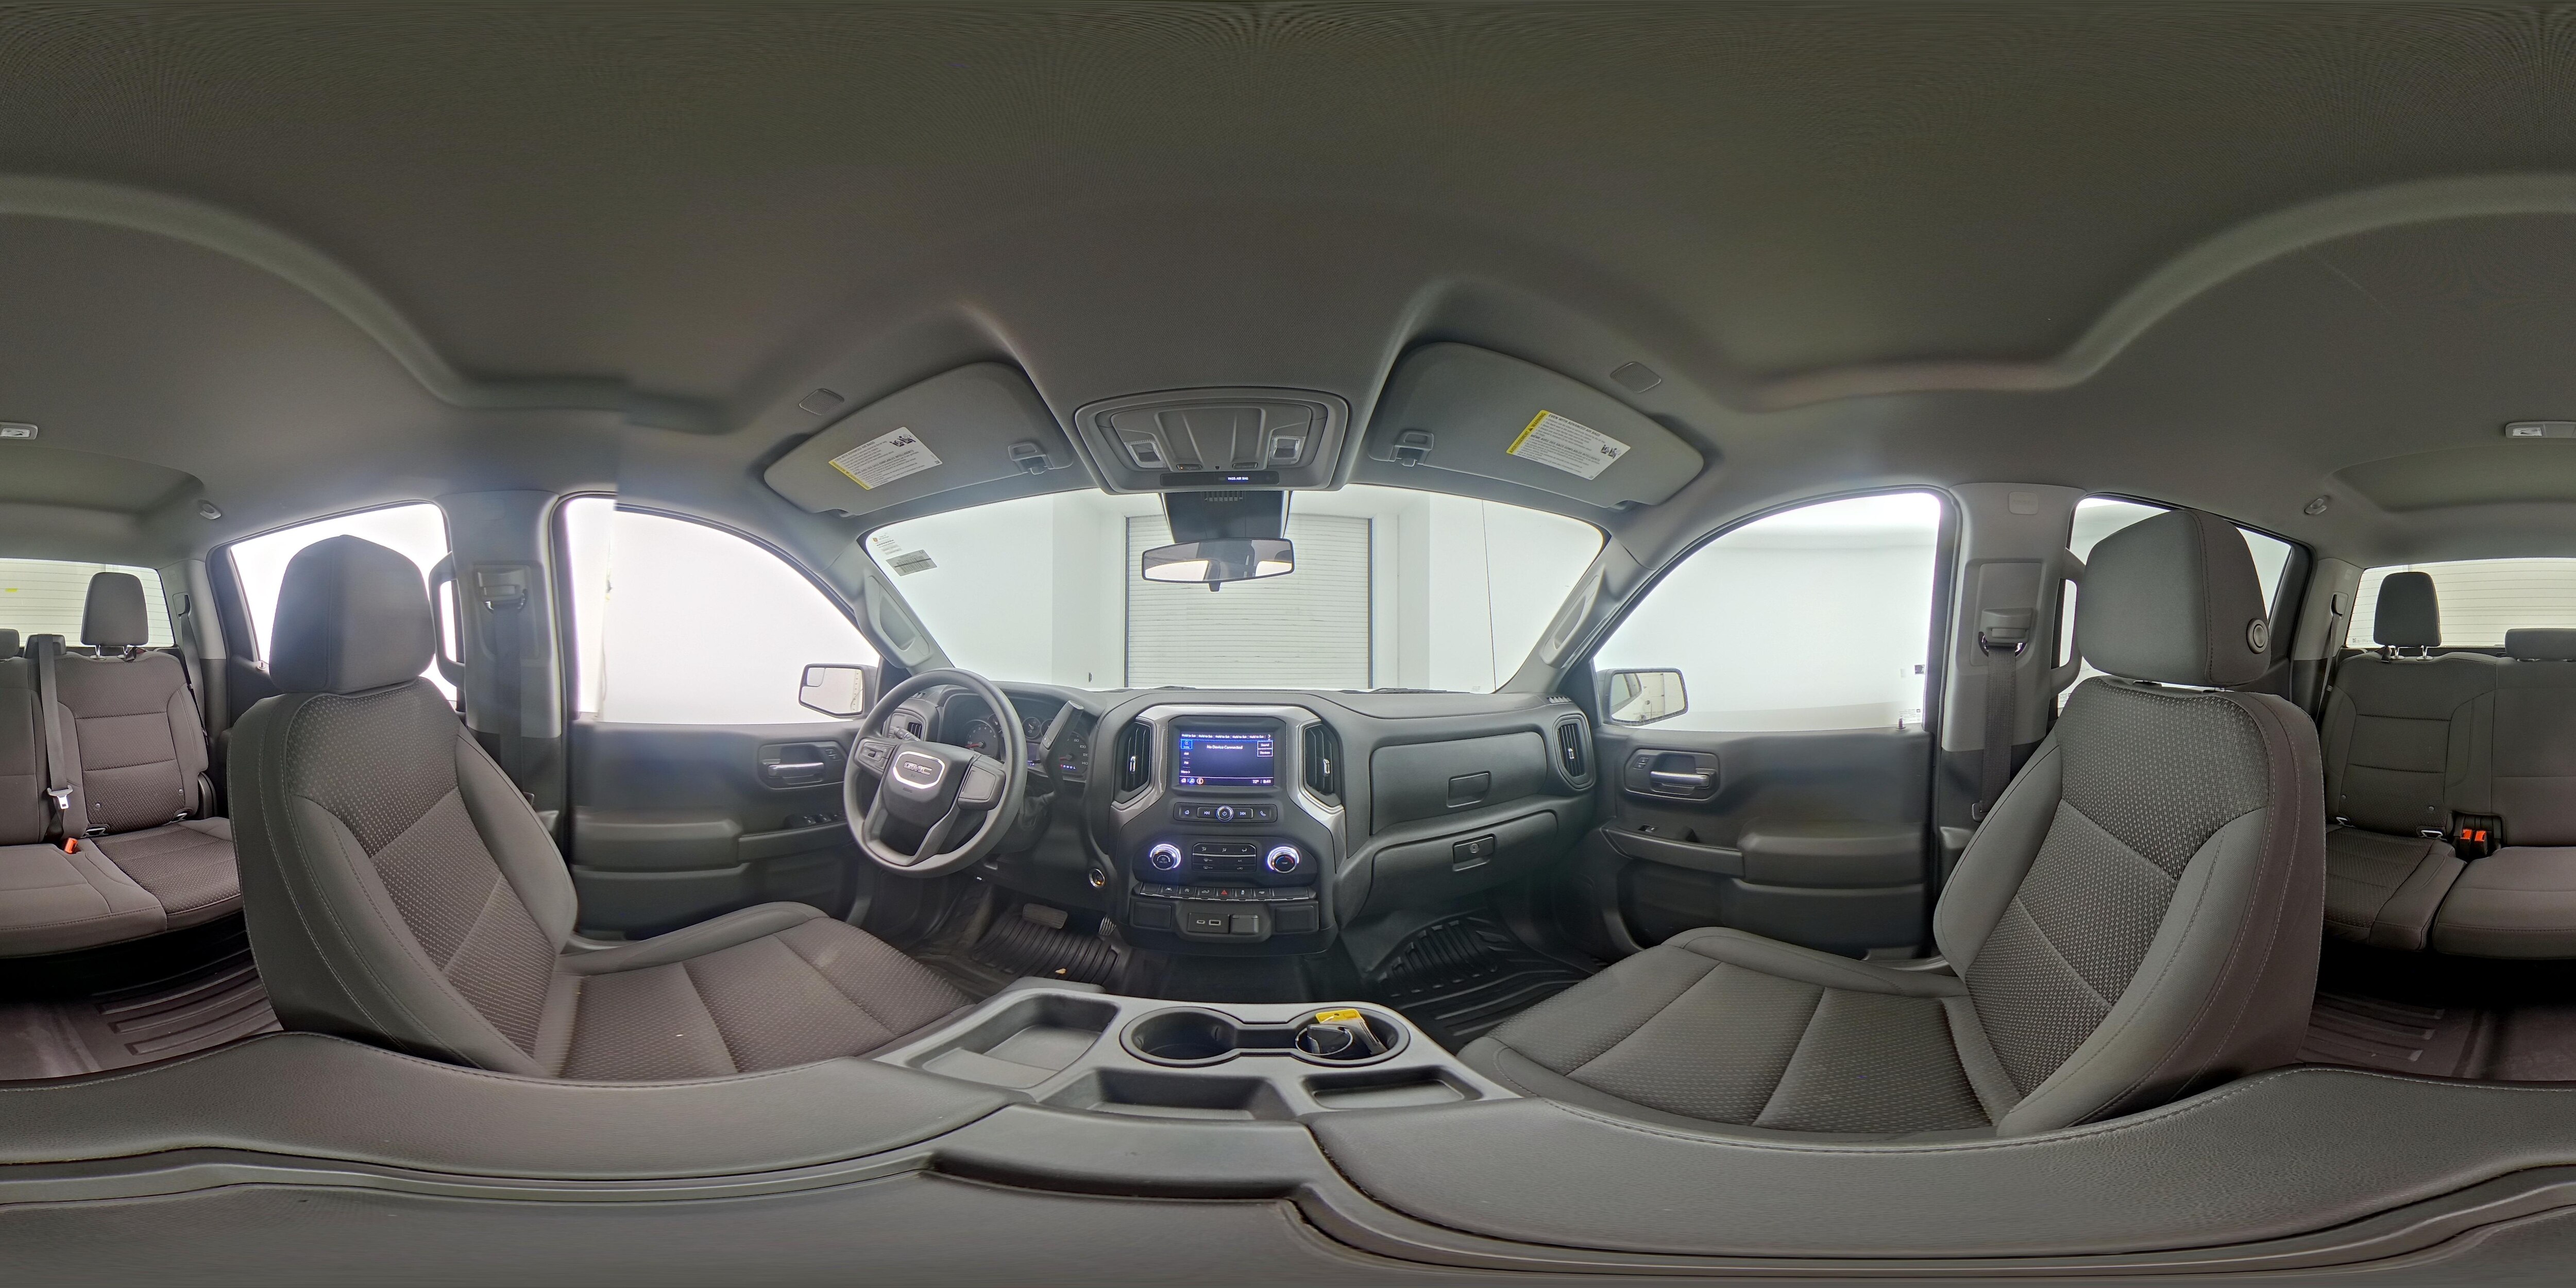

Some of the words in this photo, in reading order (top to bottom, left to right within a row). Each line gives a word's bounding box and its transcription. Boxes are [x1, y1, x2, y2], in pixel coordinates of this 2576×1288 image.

[1532, 413, 1546, 427] WARNING
[1568, 421, 1586, 430] ADVANCED
[895, 449, 914, 458] INTELLIGENTS
[904, 761, 932, 775] GMC
